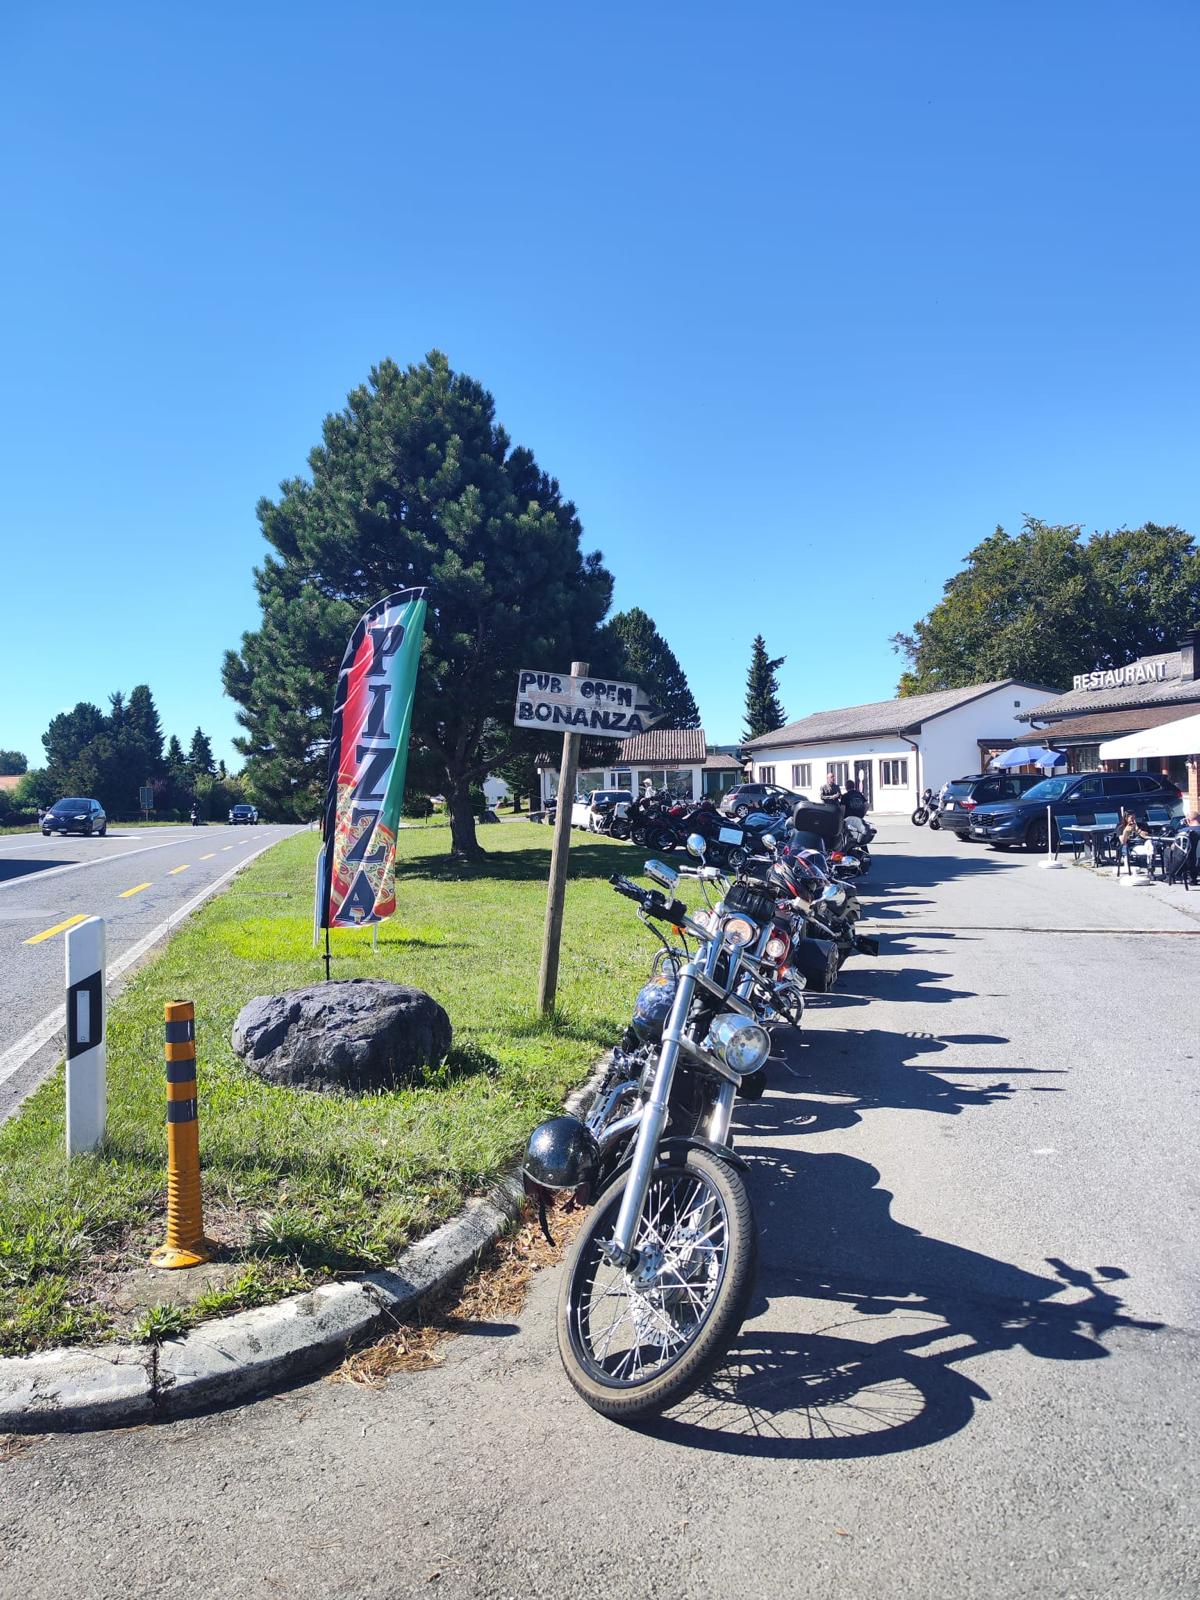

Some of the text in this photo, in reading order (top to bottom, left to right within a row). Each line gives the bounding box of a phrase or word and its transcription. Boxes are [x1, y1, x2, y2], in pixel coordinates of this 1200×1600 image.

[519, 672, 632, 707] PUB OPEN
[1073, 661, 1167, 690] RESTAURANT
[518, 701, 644, 733] BONANZA
[335, 624, 405, 922] PIZZA
